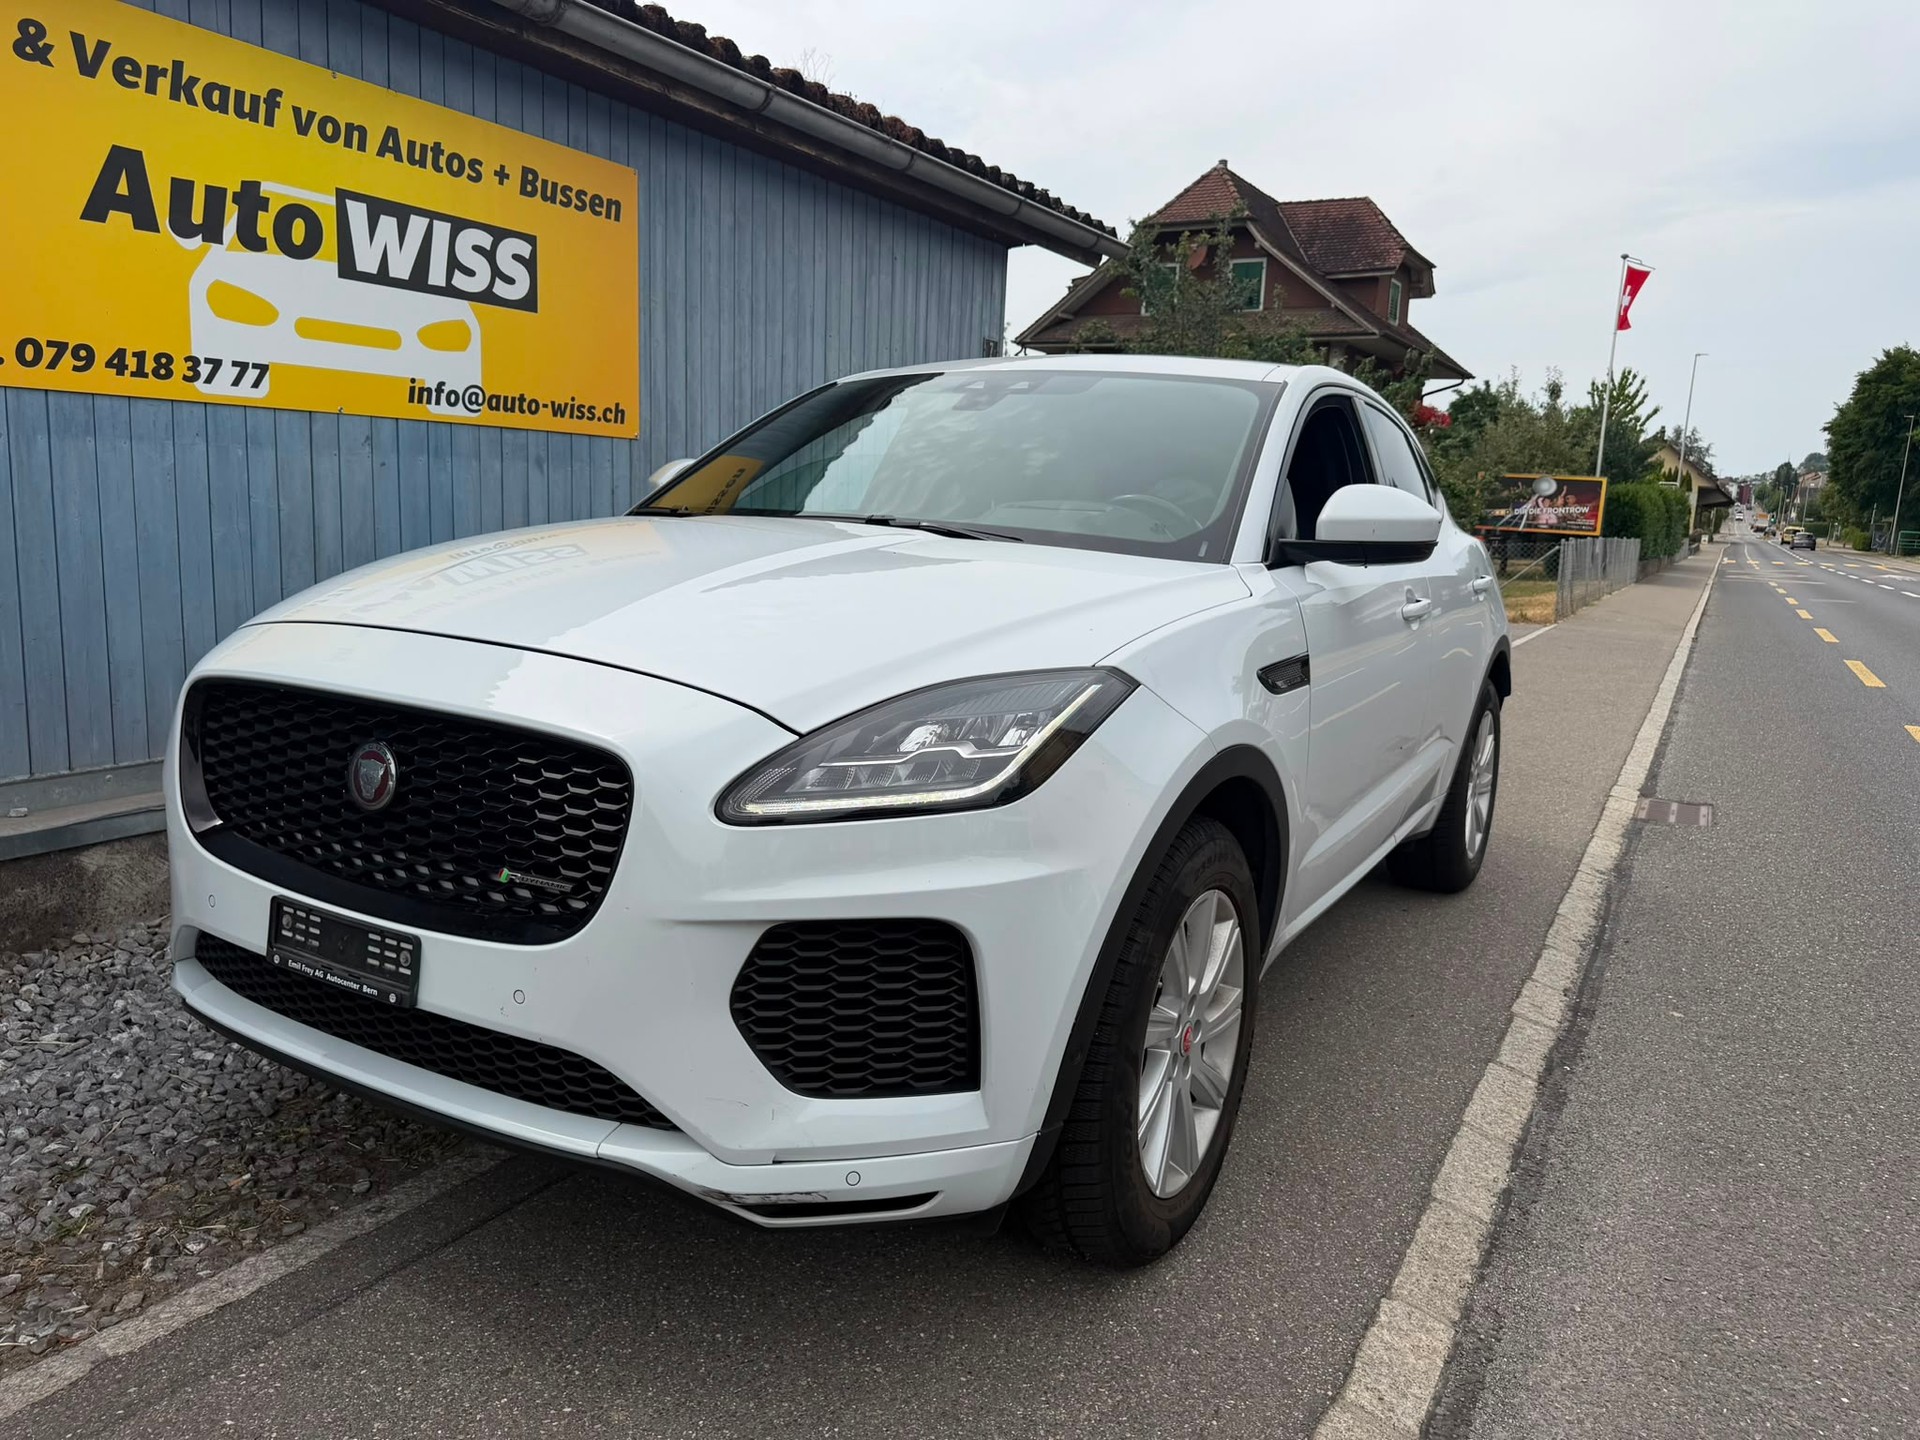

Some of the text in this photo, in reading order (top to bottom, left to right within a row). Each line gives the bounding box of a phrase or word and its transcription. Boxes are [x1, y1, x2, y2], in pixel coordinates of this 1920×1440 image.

[12, 18, 622, 222] & Verkauf von Autos + Bussen
[79, 143, 533, 301] Auto WISS
[15, 337, 270, 389] 079 418 37 77
[407, 377, 626, 425] info@auto-wiss.ch
[288, 959, 378, 996] Emil Frey AG Autocenter Bern
